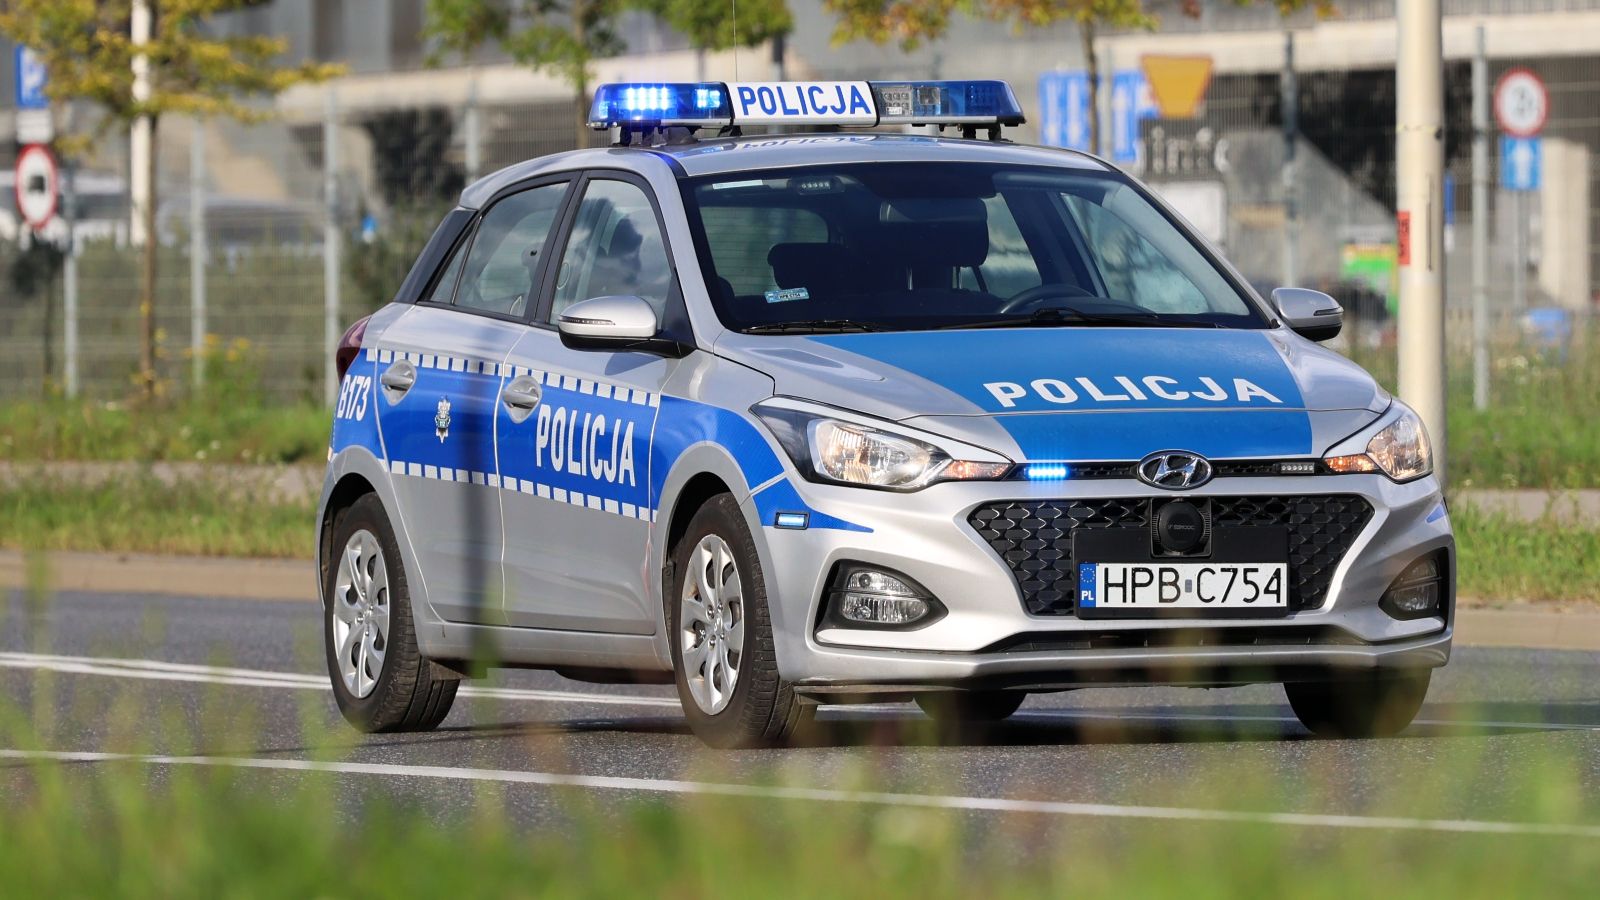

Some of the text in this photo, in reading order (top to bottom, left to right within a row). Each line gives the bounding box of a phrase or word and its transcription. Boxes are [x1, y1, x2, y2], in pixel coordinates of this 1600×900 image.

[737, 85, 872, 116] POLICJA
[337, 374, 372, 421] B173
[982, 375, 1283, 407] POLICJA
[536, 403, 636, 487] POLICJA
[1081, 590, 1094, 601] PL
[1103, 567, 1282, 604] HPB C754
